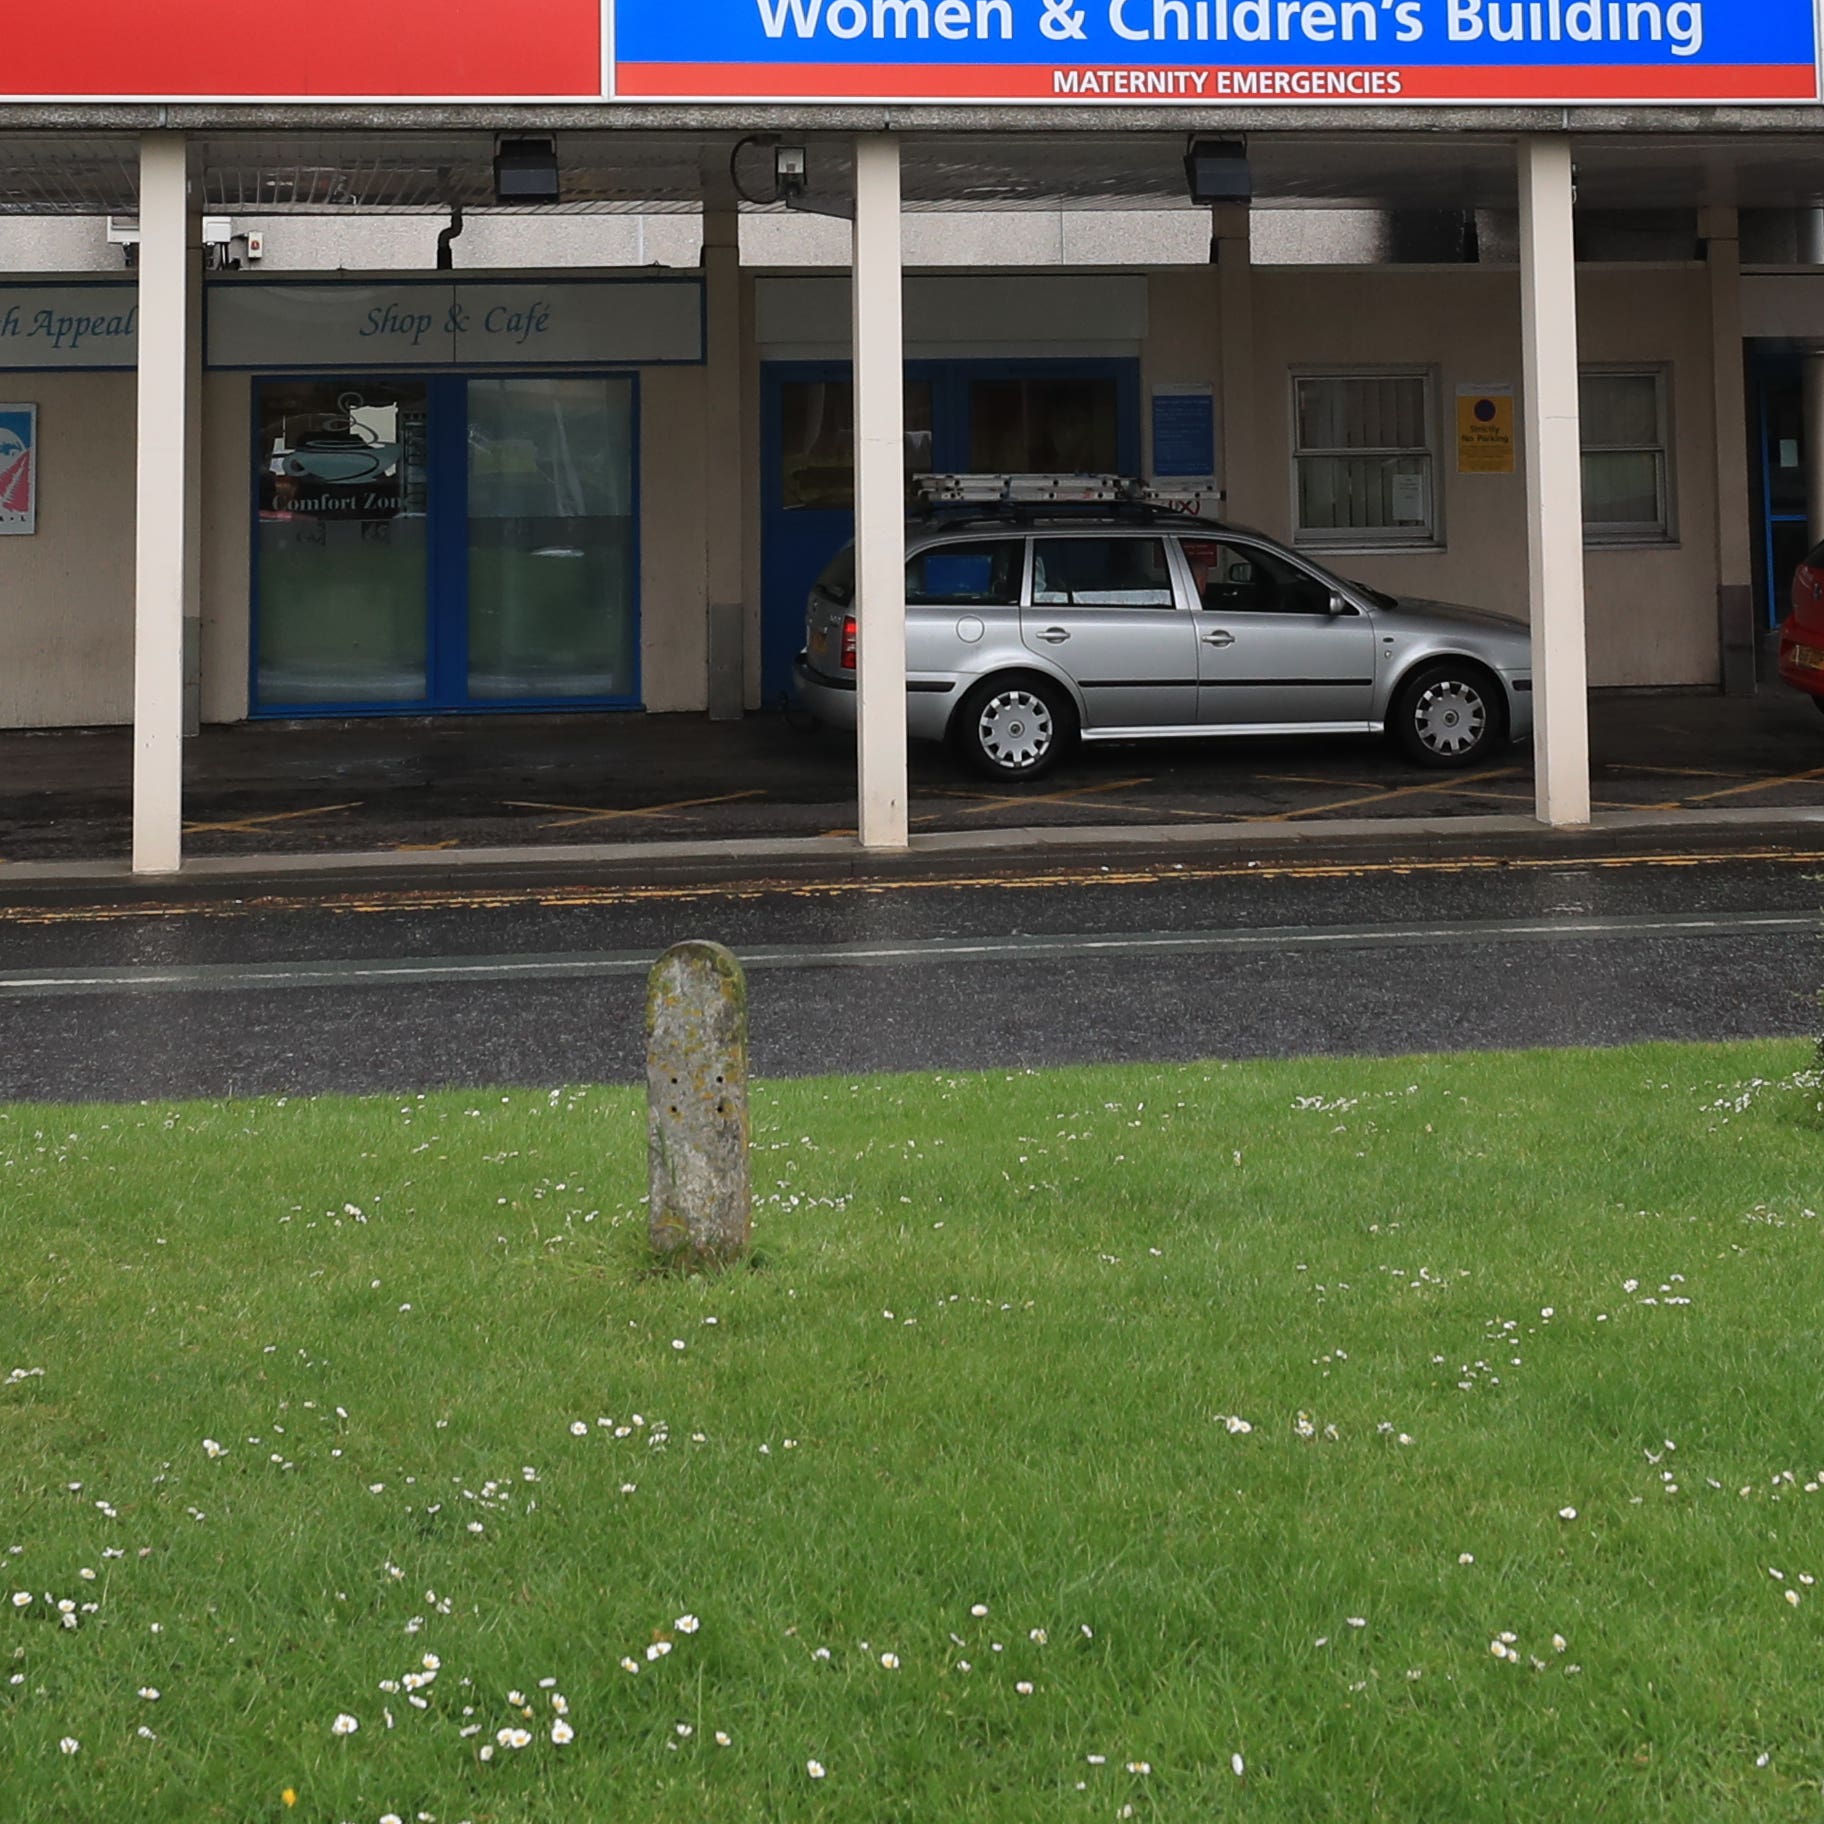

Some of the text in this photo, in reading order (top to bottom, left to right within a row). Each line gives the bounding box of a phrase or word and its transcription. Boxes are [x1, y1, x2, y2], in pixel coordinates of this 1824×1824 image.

[1053, 70, 1402, 96] MATERNITY EMERGENCIES
[25, 304, 139, 349] Appeal
[359, 301, 551, 346] Shop & Café
[272, 493, 356, 511] Comfort
